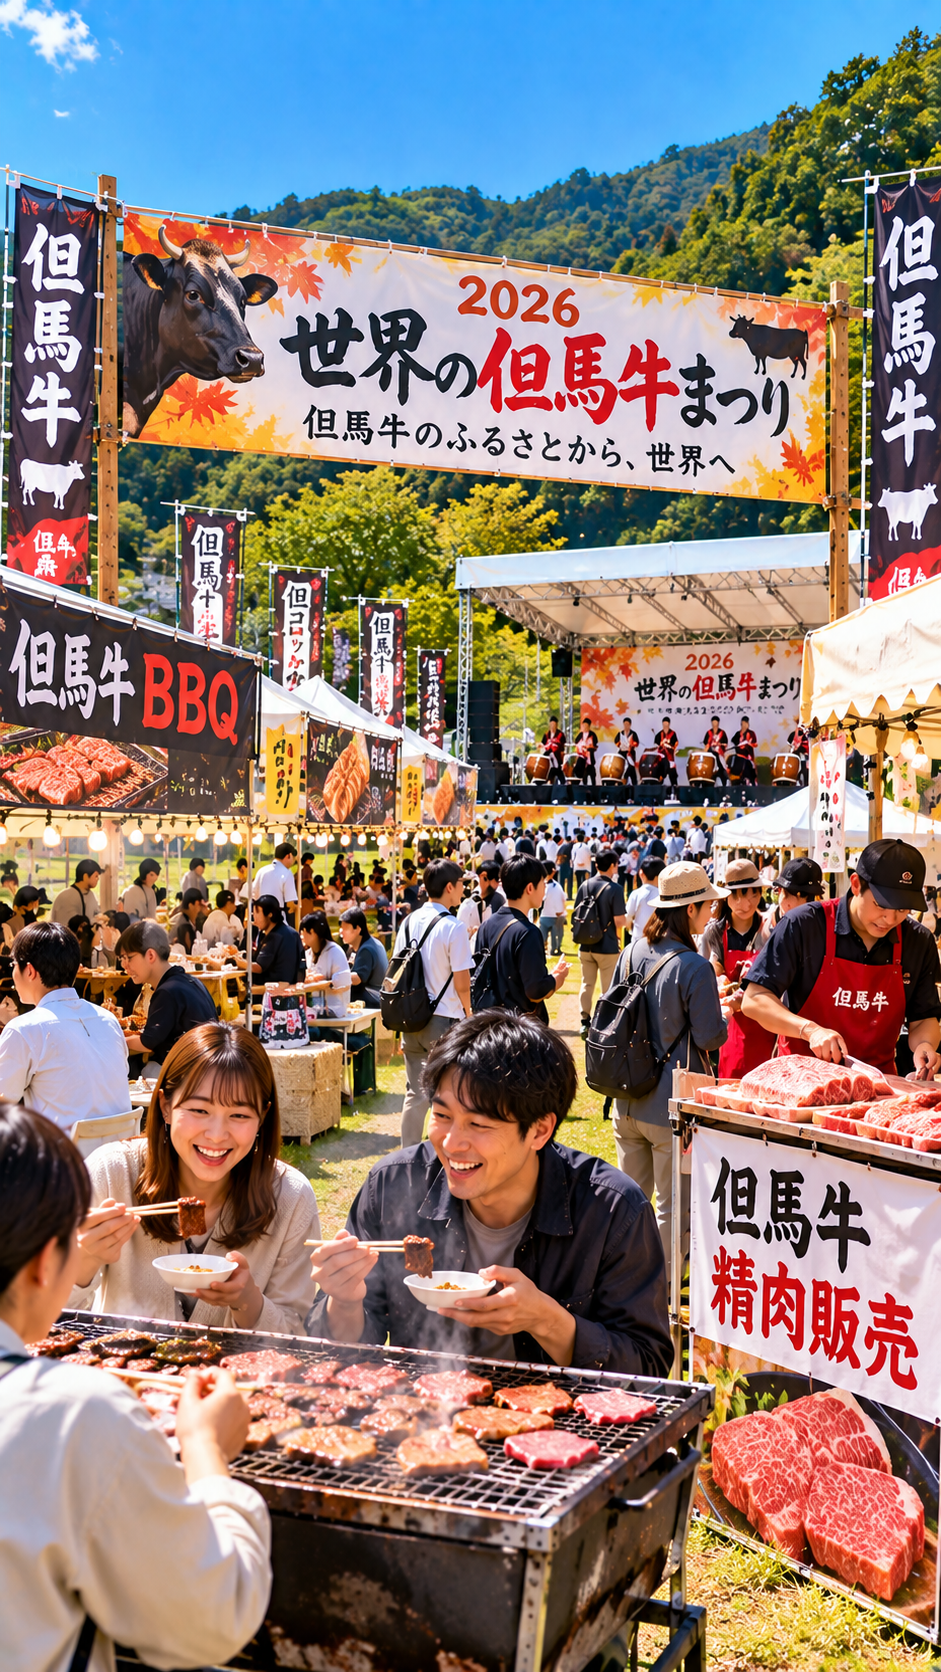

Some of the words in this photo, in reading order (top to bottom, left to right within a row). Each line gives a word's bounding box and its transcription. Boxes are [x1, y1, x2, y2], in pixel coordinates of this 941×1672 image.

[22, 223, 84, 448] 但馬牛
[457, 275, 580, 328] 2026
[879, 215, 938, 467] 但馬牛
[280, 307, 790, 438] 世界の但馬牛まつり
[303, 404, 736, 477] 但馬牛のふるさとから、世界へ
[8, 618, 136, 727] 但馬牛
[142, 653, 239, 747] BBQ
[634, 671, 800, 703] 世界の但馬牛まつり
[685, 652, 734, 671] 2026
[832, 986, 889, 1013] 但馬牛
[710, 1156, 871, 1274] 但馬牛
[710, 1245, 919, 1391] 精肉販売
